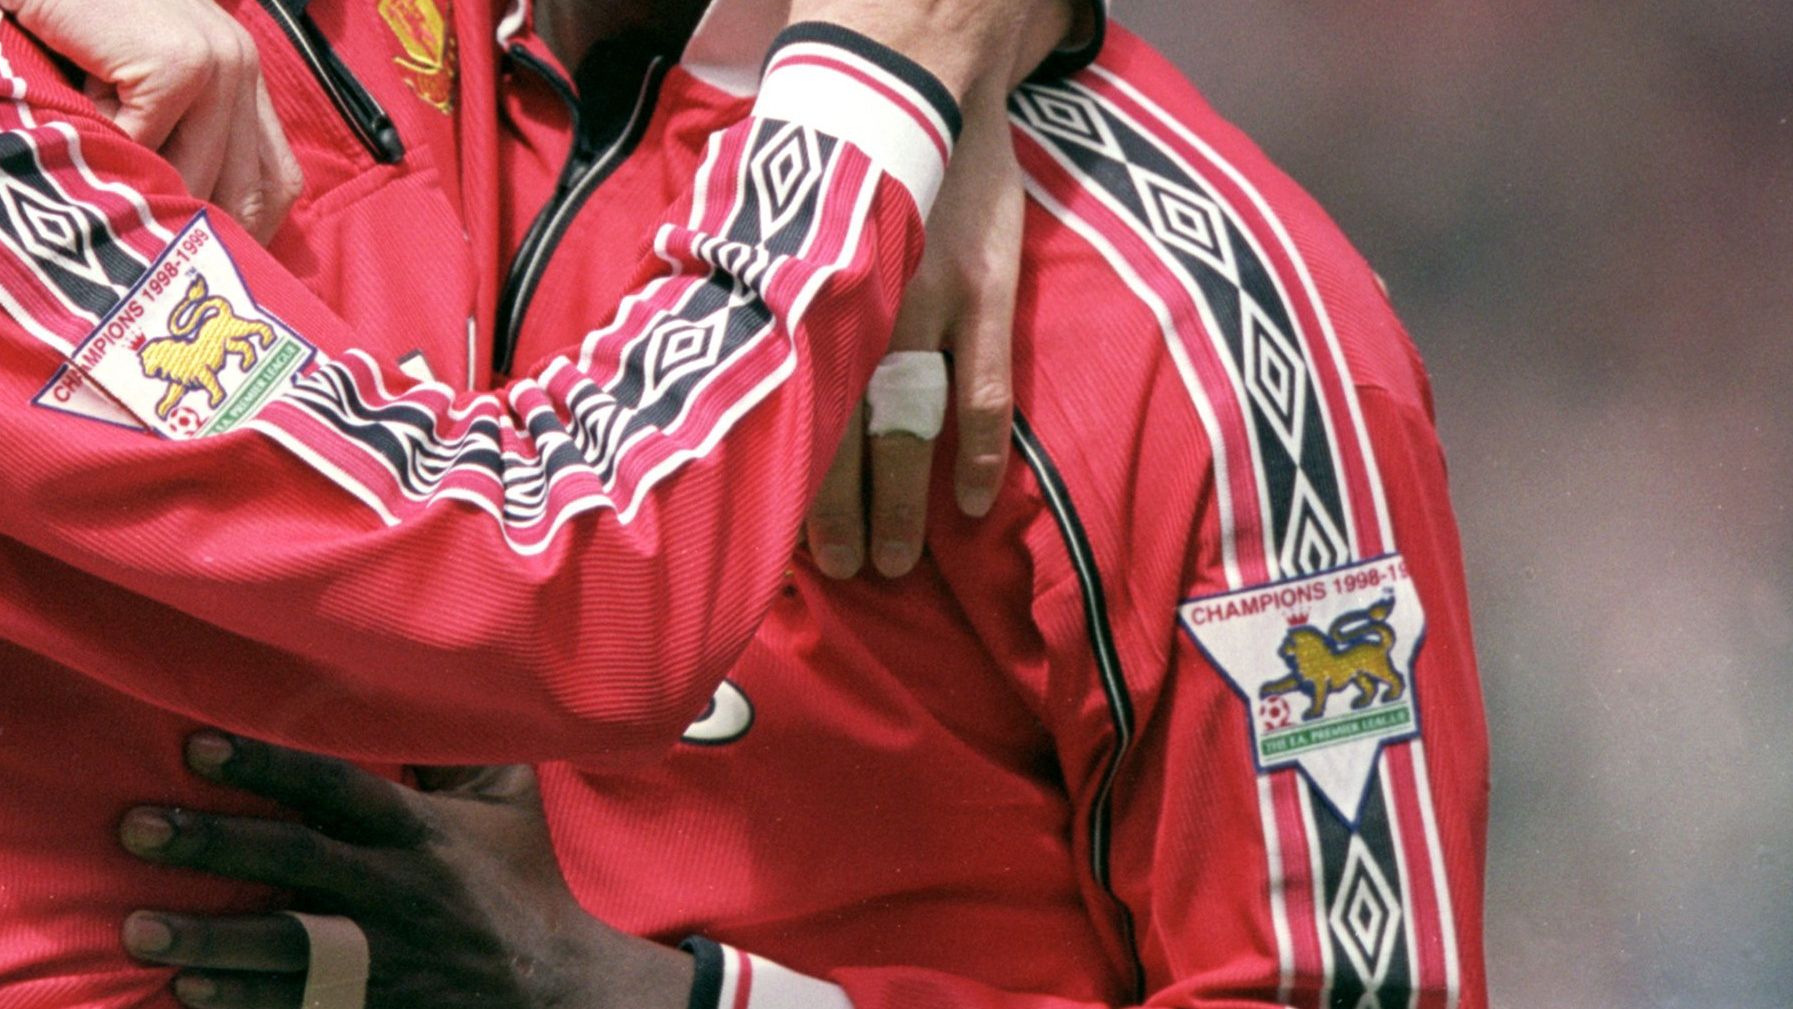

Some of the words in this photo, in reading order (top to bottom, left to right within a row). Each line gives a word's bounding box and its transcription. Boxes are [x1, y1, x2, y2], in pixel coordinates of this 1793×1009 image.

[53, 301, 145, 403] CHAMPIONS
[142, 227, 209, 302] 1998-1999
[1191, 581, 1327, 626] CHAMPIONS
[1310, 721, 1360, 742] PREMIER
